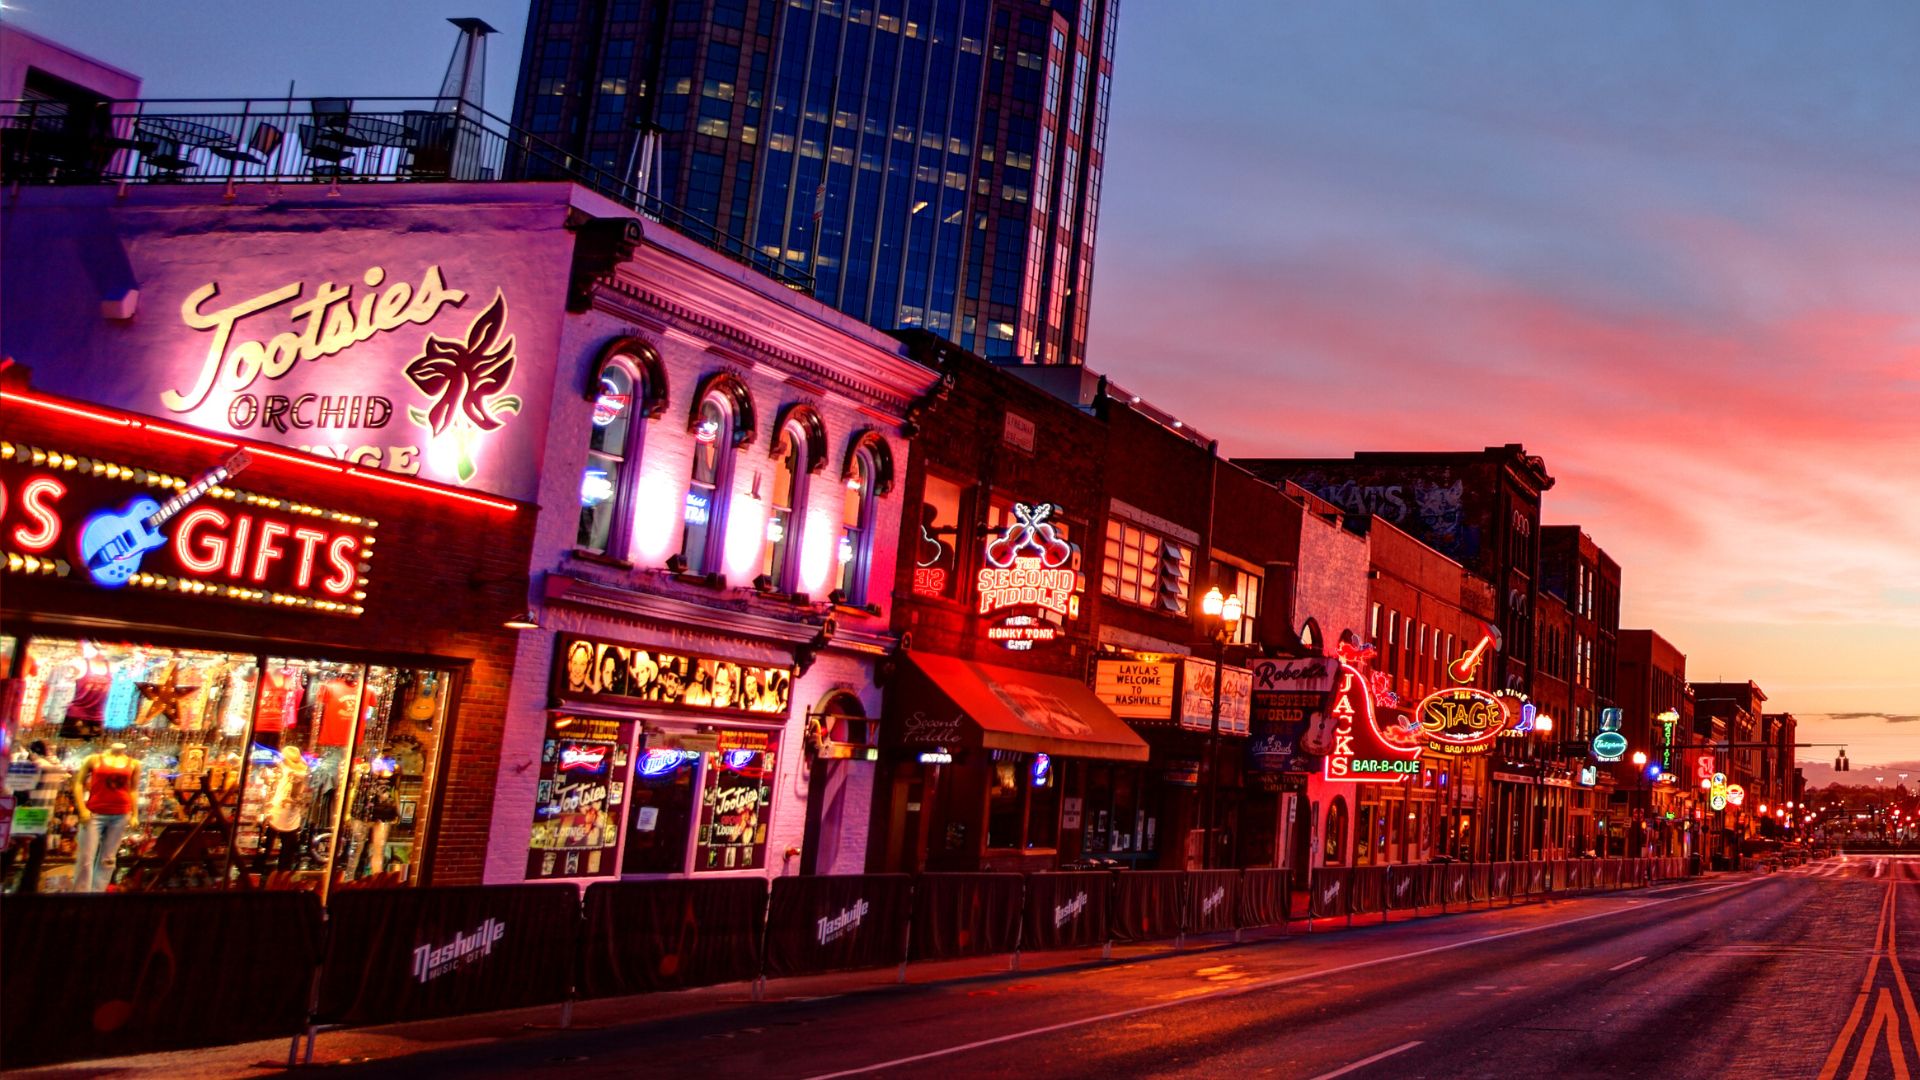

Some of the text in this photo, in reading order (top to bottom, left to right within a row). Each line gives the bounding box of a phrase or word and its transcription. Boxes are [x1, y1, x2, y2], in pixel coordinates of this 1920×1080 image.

[160, 265, 468, 413] Tootsies
[227, 393, 393, 433] ORCHID
[175, 507, 358, 595] GIFTS
[1014, 556, 1043, 570] THE
[978, 569, 1075, 592] SECOND
[980, 587, 1068, 614] FIDDLE
[988, 628, 1054, 640] HONKY TONK
[1116, 674, 1161, 686] WELCOME
[1132, 686, 1142, 695] TO
[1453, 690, 1471, 700] THE
[1505, 688, 1528, 702] TIME
[1115, 695, 1161, 706] NASHVILLE
[905, 711, 964, 730] Second
[1422, 696, 1503, 732] STAGE
[904, 728, 963, 743] Fiddle
[1429, 741, 1489, 754] ON BROADWAY
[1351, 758, 1420, 773] BAR-B-QUE
[554, 782, 607, 813] Tootsies
[716, 786, 758, 815] Tootsies
[817, 897, 869, 945] Nashville
[414, 917, 505, 983] Nashville
